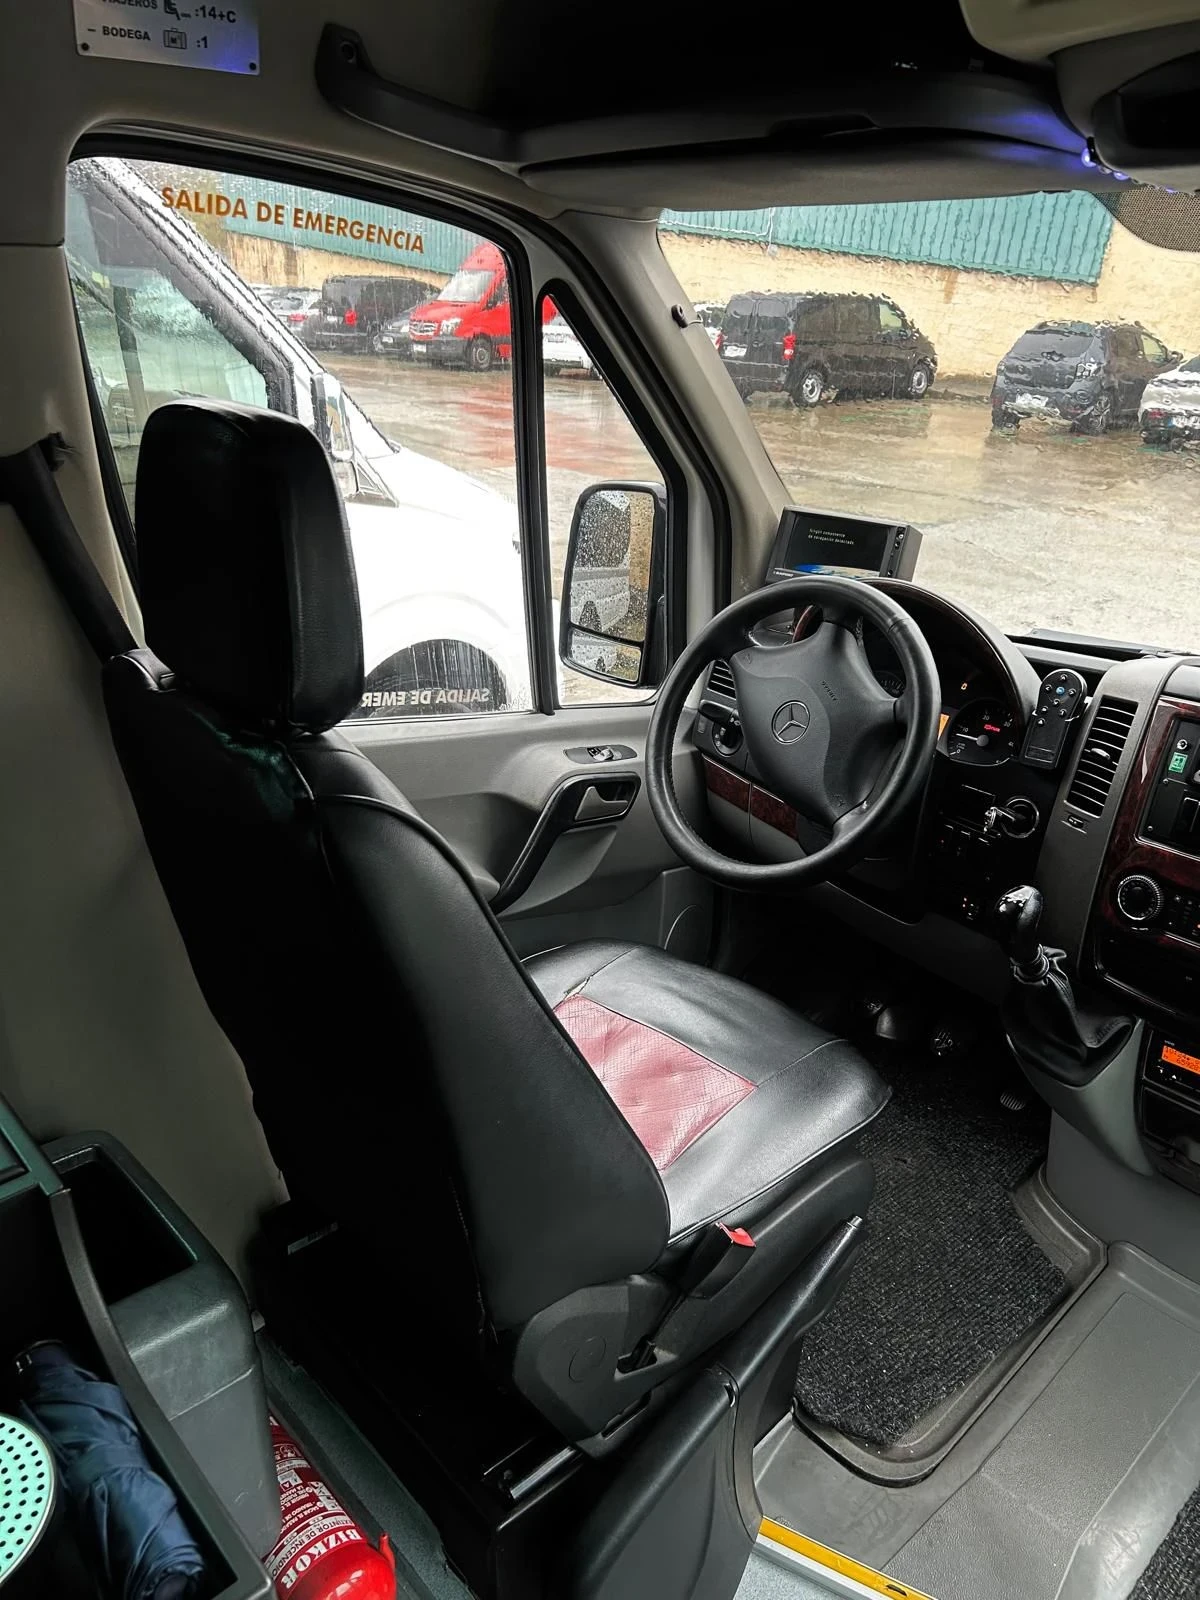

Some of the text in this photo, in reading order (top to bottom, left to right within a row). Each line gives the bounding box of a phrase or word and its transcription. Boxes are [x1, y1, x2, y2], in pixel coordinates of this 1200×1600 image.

[102, 25, 151, 41] BODEGA
[161, 186, 425, 253] SALIDA DE EMERGENCIA
[304, 1529, 317, 1541] DE
[280, 1528, 363, 1589] BIZKOR
